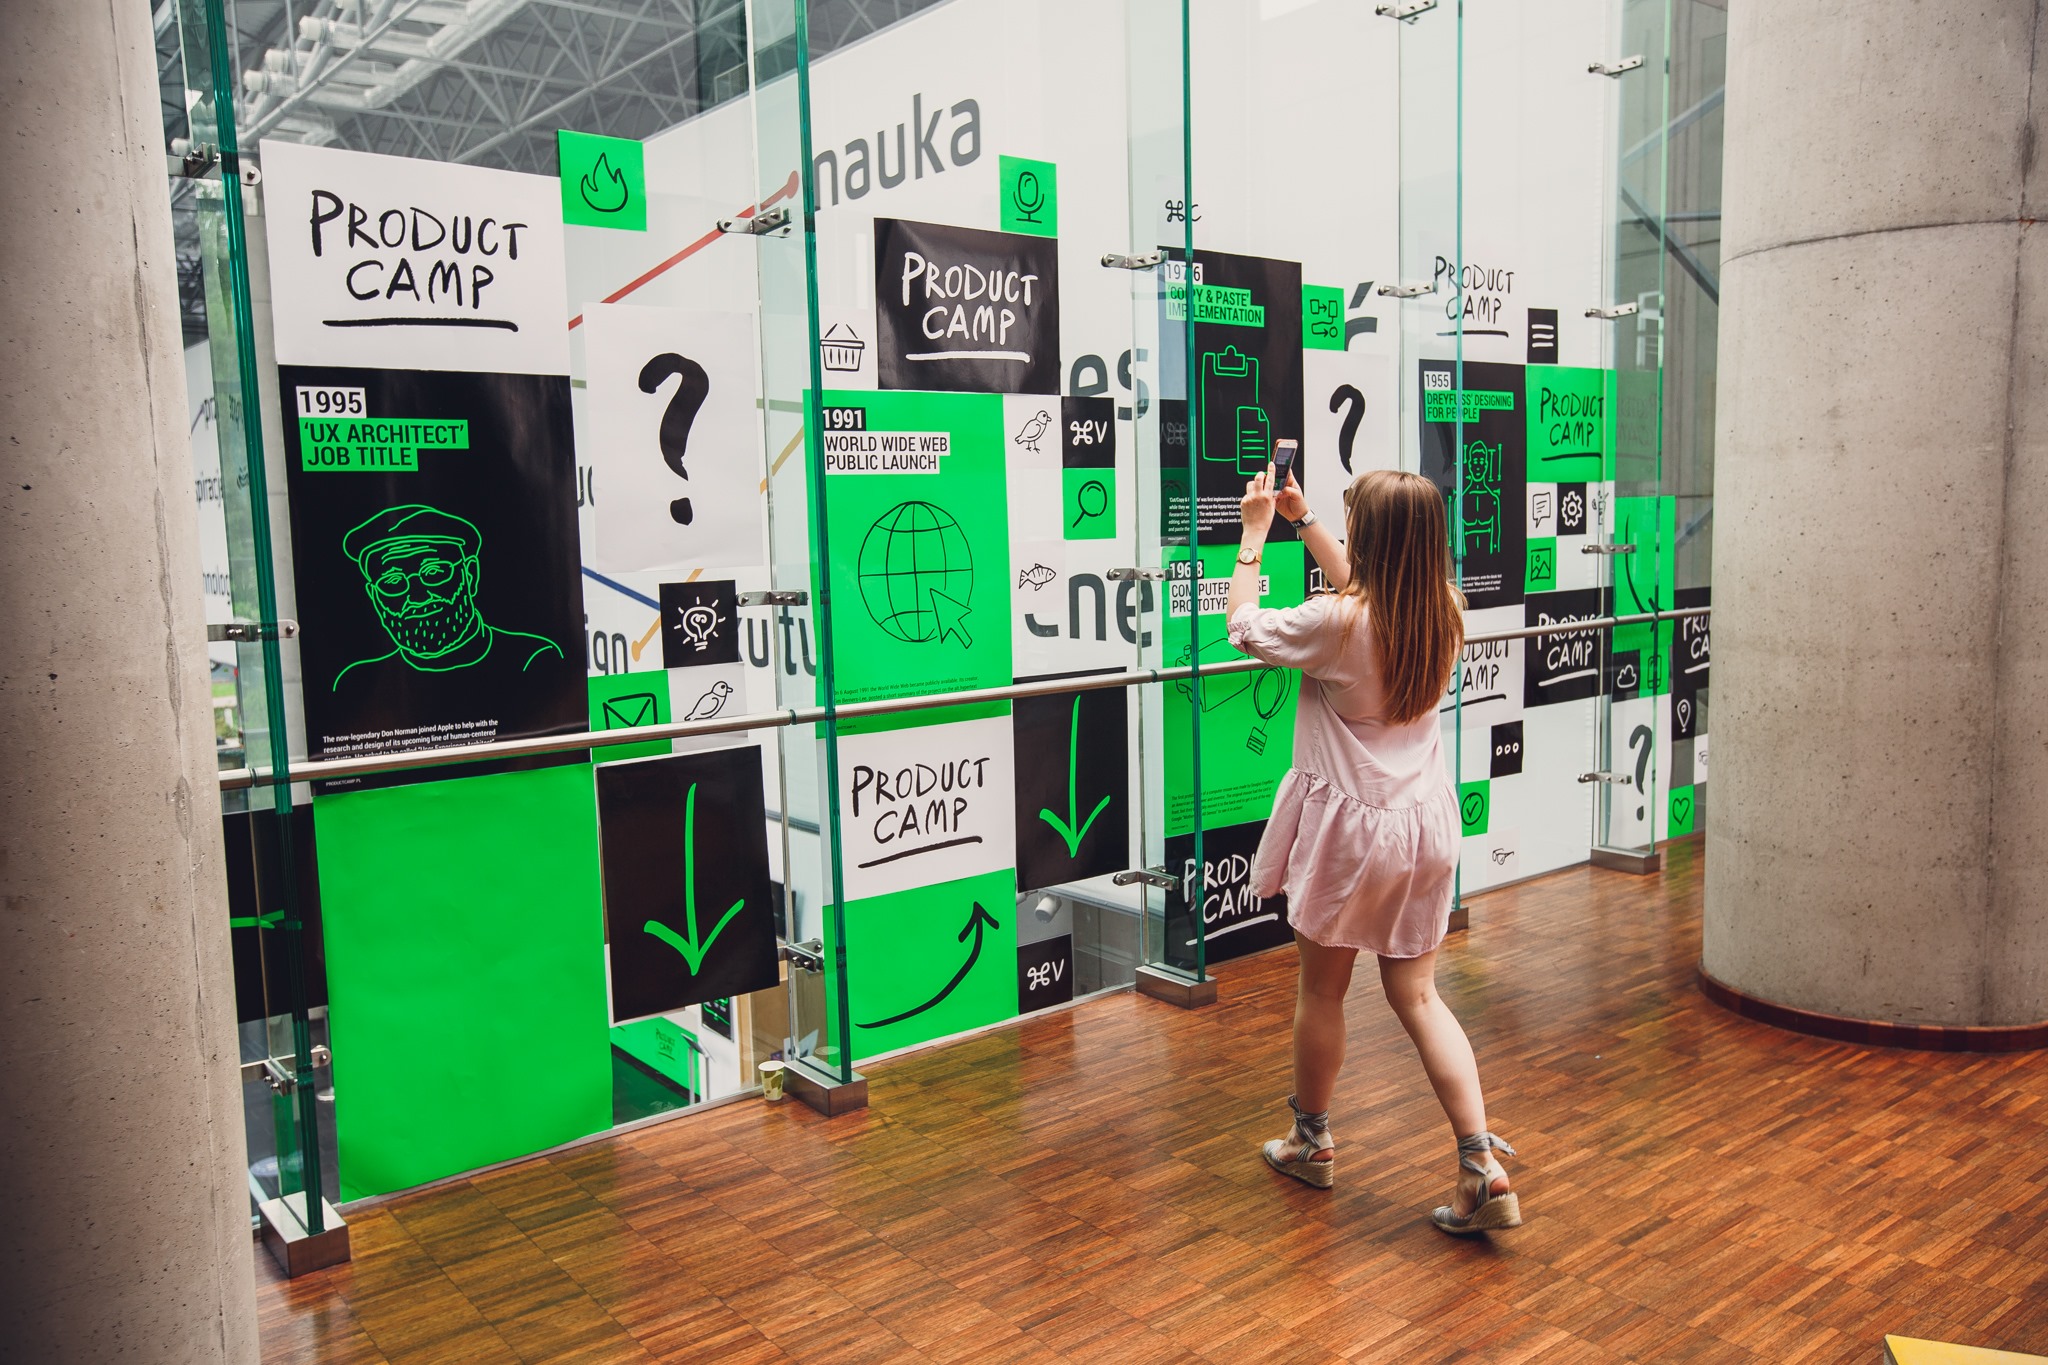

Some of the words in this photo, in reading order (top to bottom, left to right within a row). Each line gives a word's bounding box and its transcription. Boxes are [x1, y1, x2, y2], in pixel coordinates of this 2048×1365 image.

[813, 92, 981, 212] nauka
[309, 189, 528, 261] PRODUCT
[346, 258, 494, 309] CAMP
[902, 252, 1039, 306] PRODUCT
[1434, 256, 1515, 294] PRODUCT
[1206, 290, 1214, 304] &
[1215, 290, 1250, 307] PASTE'
[1446, 295, 1502, 324] CAMP
[922, 304, 1016, 345] CAMP
[1425, 374, 1449, 388] 1955
[300, 390, 363, 415] 1995
[1427, 407, 1444, 418] FOR
[1446, 407, 1477, 419] PEPLE
[1474, 395, 1512, 407] DESIGNING
[1540, 387, 1605, 424] PRODUCT
[822, 409, 863, 429] 1991
[304, 422, 341, 444] 'UX
[347, 424, 465, 445] ARCHITECT'
[825, 436, 878, 452] WORLD
[881, 436, 916, 452] WIDE
[919, 437, 948, 452] WEB
[1550, 423, 1594, 447] CAMP
[307, 446, 351, 466] JOB
[355, 446, 413, 466] TITLE
[826, 455, 879, 470] PUBLIC
[882, 455, 937, 470] LAUNCH
[1547, 640, 1593, 671] CAMP
[323, 735, 336, 743] The
[336, 731, 381, 742] now-legendary
[381, 730, 394, 738] Don
[394, 728, 418, 737] Norman
[418, 724, 437, 734] joined
[437, 723, 454, 733] Apple
[454, 722, 461, 730] to
[461, 721, 475, 730] help
[323, 744, 351, 754] research
[351, 743, 363, 751] and
[363, 741, 384, 750] design
[384, 739, 392, 747] of
[392, 738, 401, 746] its
[401, 736, 431, 747] upcoming
[431, 734, 442, 742] line
[442, 732, 450, 740] of
[450, 729, 496, 740] human-centered
[852, 757, 990, 817] PRODUCT
[874, 797, 968, 844] CAMP
[1183, 853, 1255, 903] PROD
